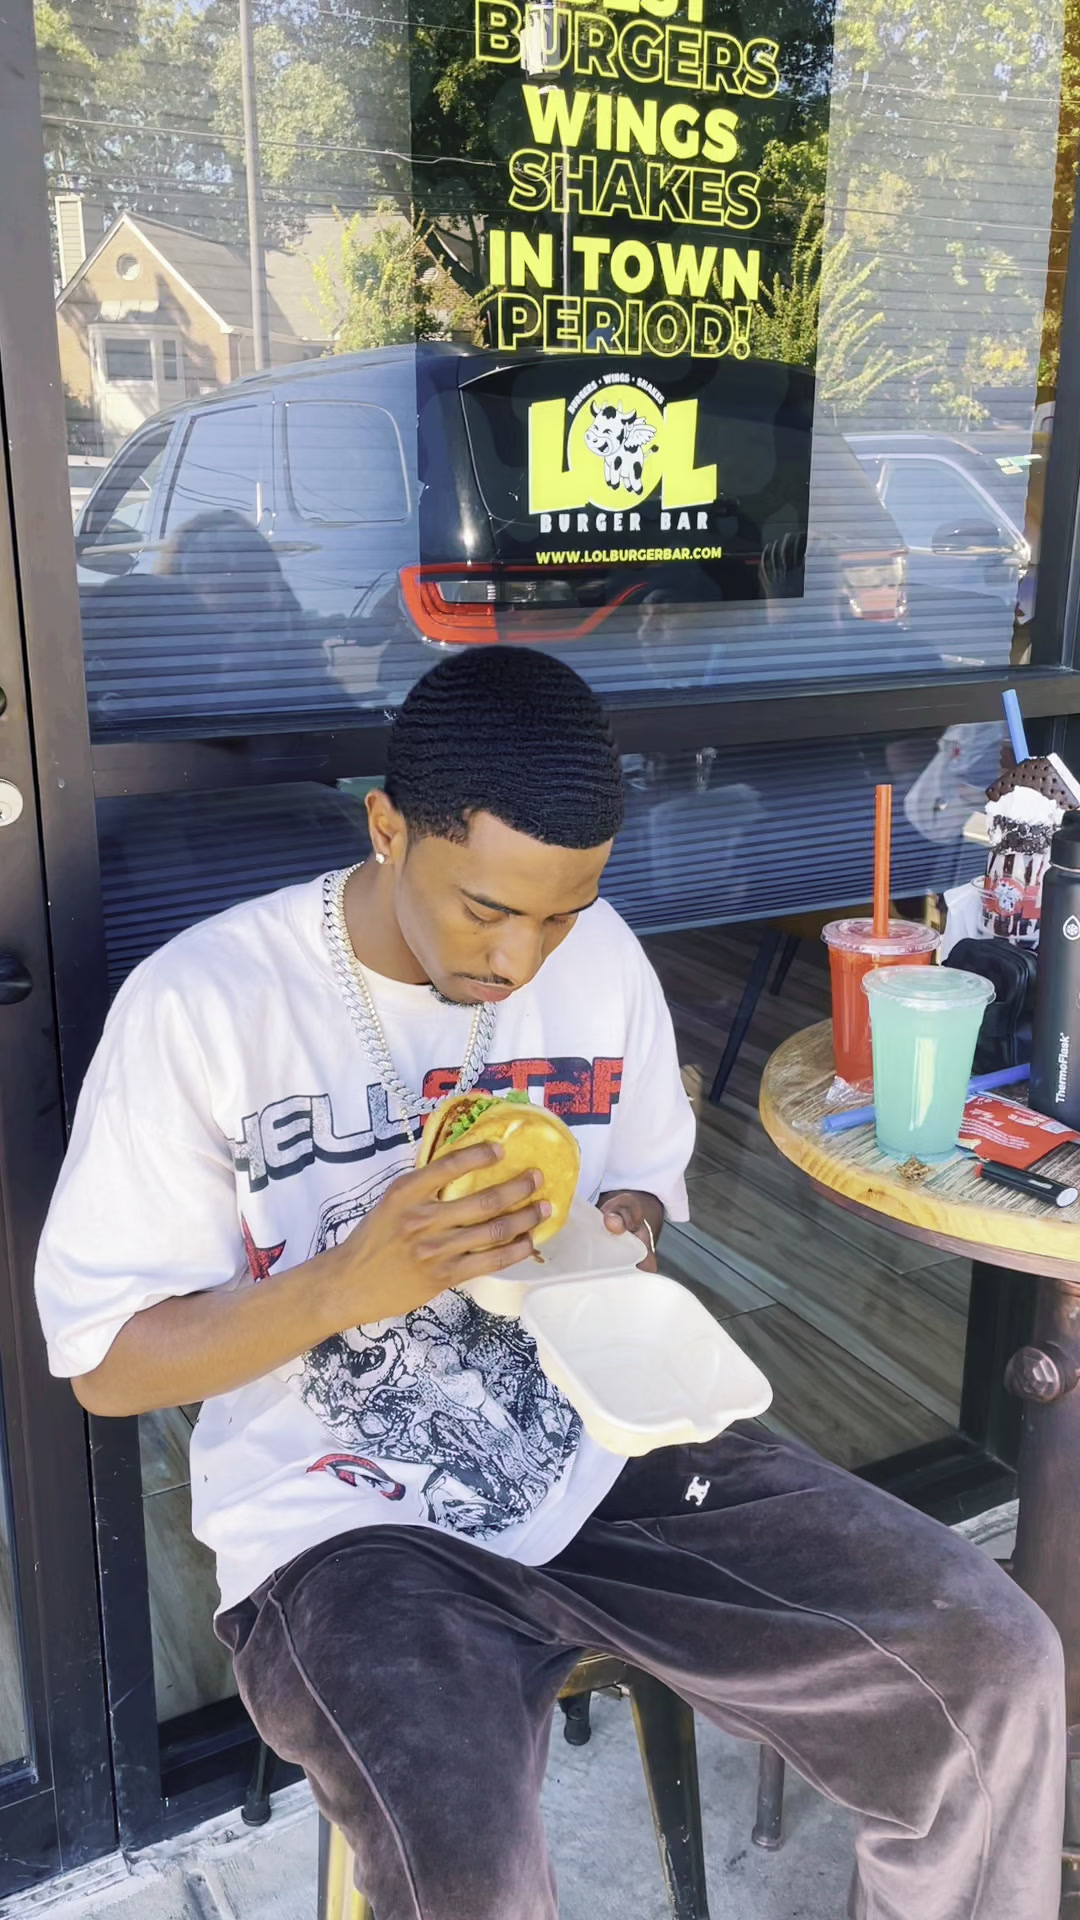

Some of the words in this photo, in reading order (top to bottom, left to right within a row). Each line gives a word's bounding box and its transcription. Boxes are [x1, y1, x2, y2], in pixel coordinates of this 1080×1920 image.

[475, 0, 780, 98] BURGERS
[522, 84, 739, 163] WINGS
[508, 149, 761, 229] SHAKES
[489, 230, 553, 288] IN
[573, 236, 760, 301] TOWN
[498, 292, 752, 360] PERIOD!
[602, 372, 630, 385] WINGS
[636, 377, 665, 404] SHAKES
[528, 383, 717, 515] LOL
[536, 547, 722, 564] WWW.LOLBURGERBAR.COM
[540, 512, 641, 533] BURGER
[660, 511, 708, 530] BAR
